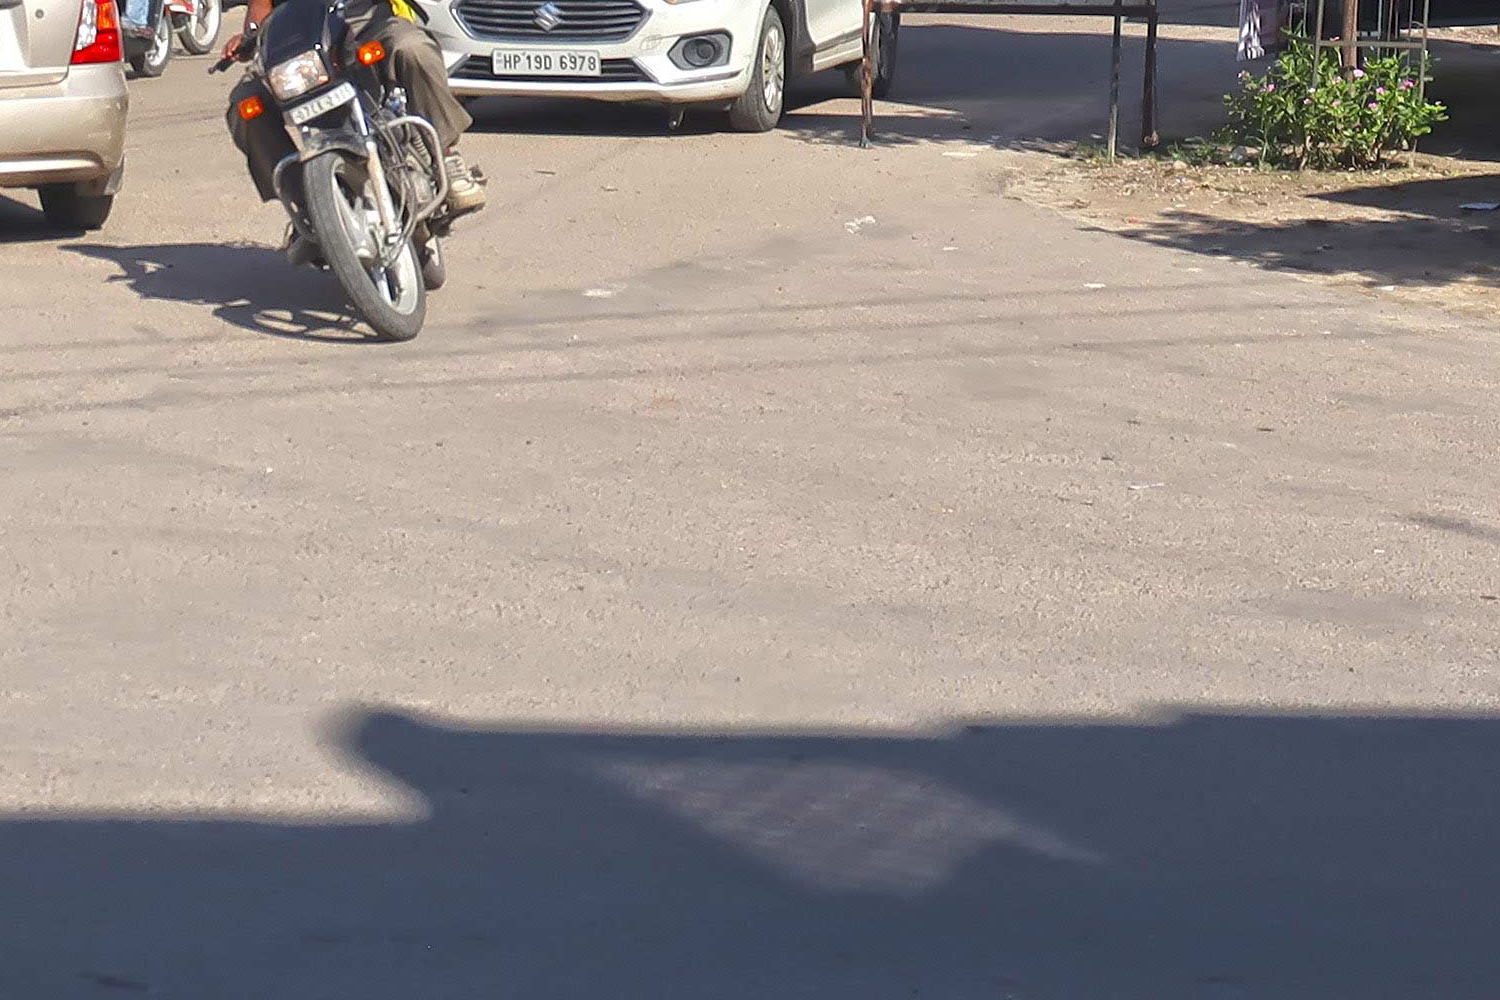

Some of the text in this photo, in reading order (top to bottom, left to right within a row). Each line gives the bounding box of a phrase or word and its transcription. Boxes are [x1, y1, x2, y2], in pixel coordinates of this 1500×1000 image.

[502, 54, 521, 71] HP
[526, 54, 552, 70] 19D
[559, 54, 597, 72] 6978
